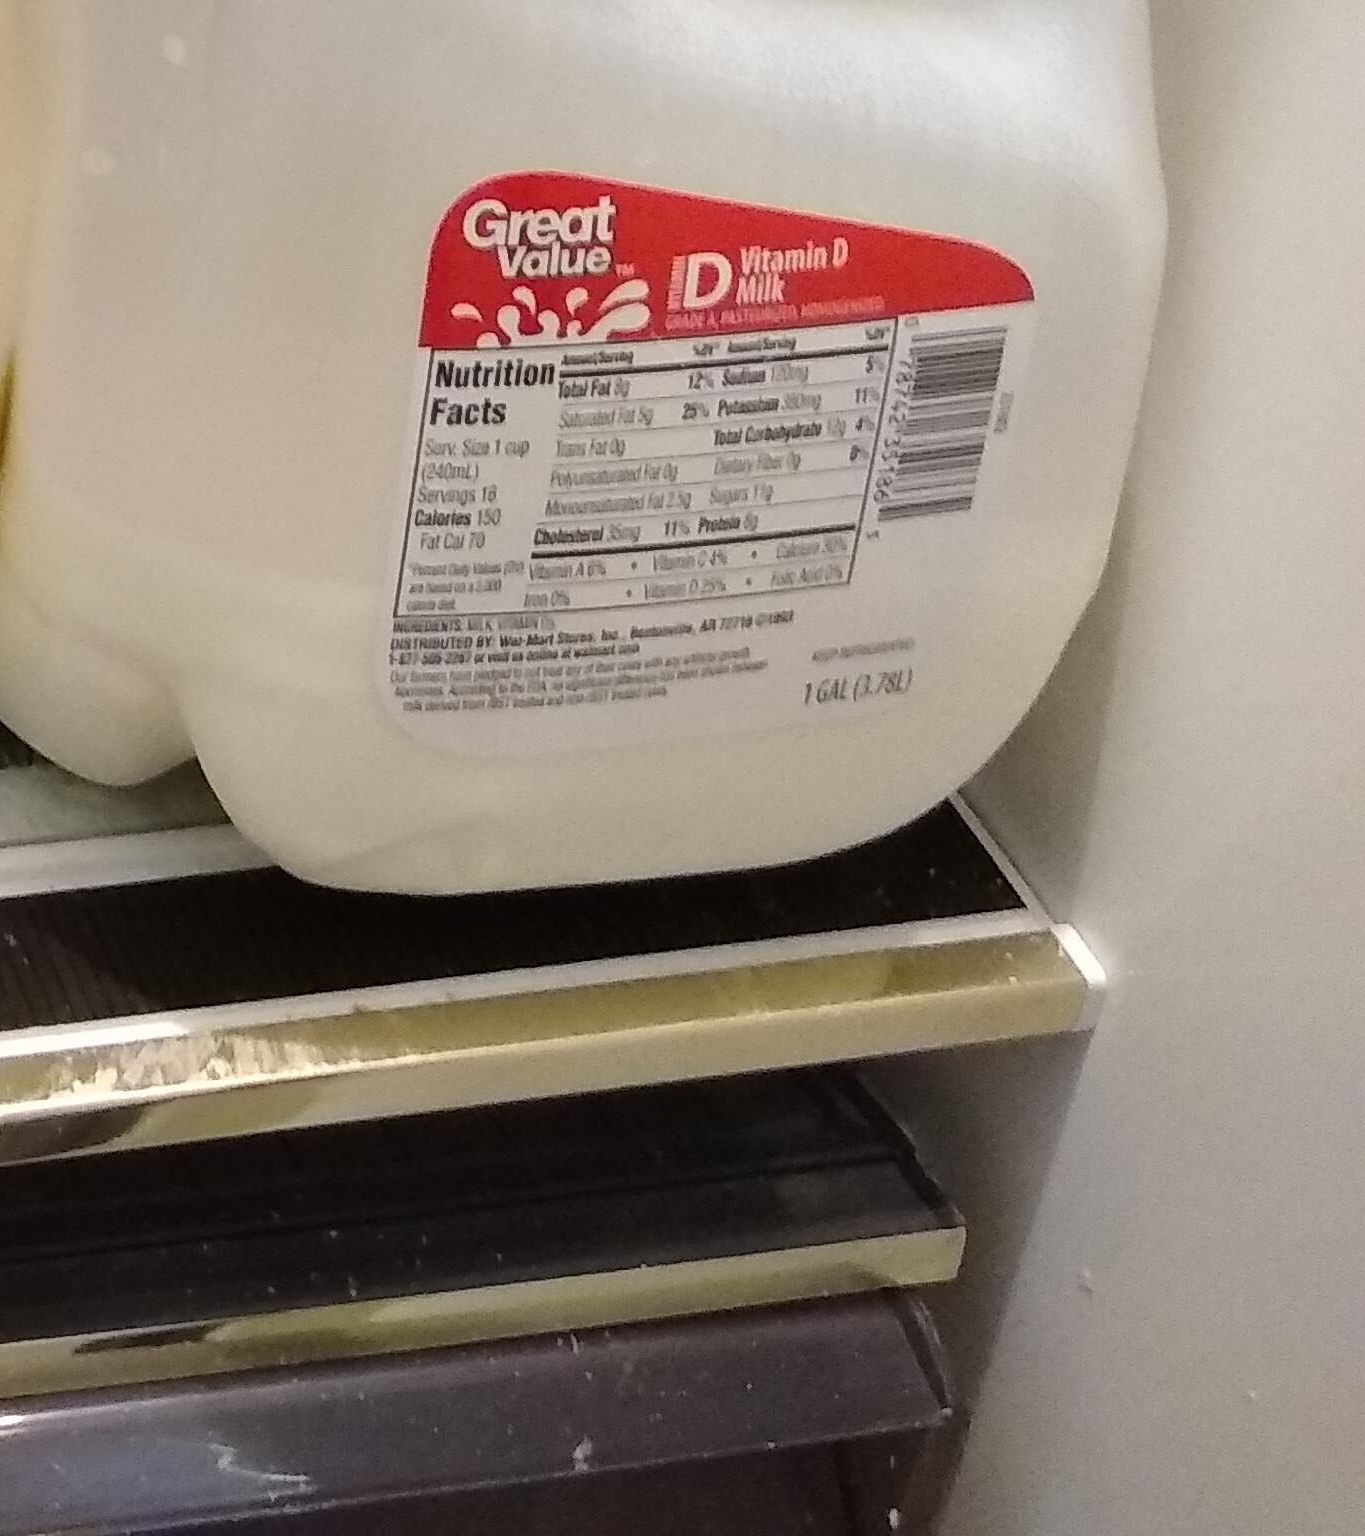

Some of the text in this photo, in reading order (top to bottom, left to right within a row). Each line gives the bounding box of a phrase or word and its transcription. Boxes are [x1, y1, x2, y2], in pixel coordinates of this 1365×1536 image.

[463, 195, 617, 249] Great
[497, 241, 612, 279] Value
[740, 237, 849, 275] Vitamin D
[736, 273, 786, 306] Milk
[435, 359, 556, 388] Nutrition
[429, 397, 507, 425] Facts
[415, 509, 471, 527] Calories
